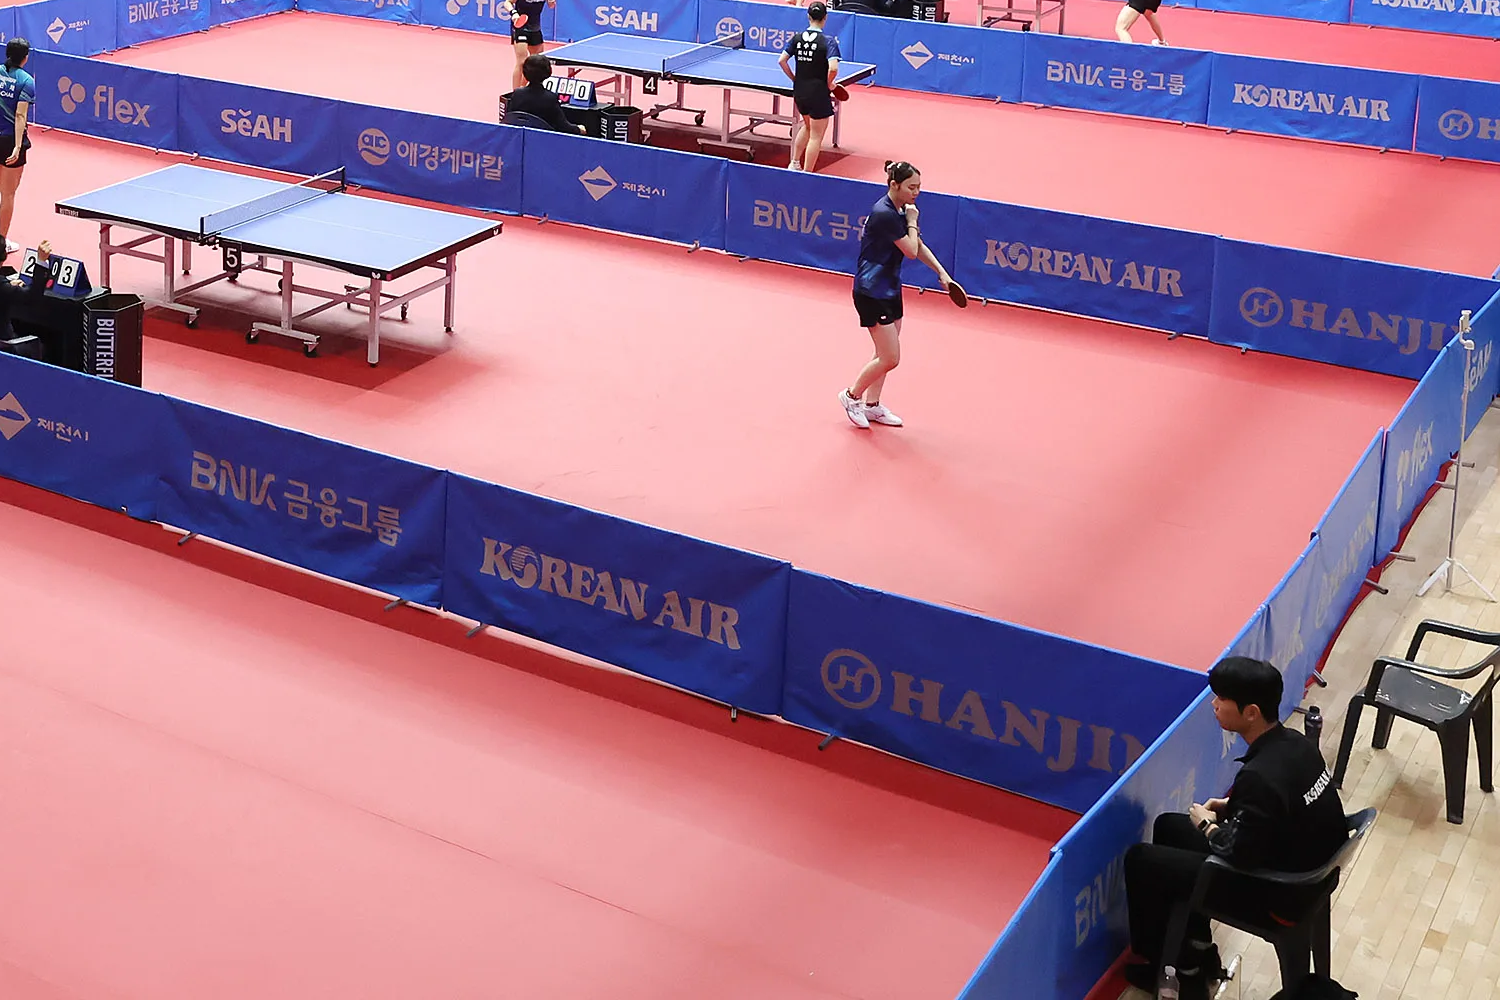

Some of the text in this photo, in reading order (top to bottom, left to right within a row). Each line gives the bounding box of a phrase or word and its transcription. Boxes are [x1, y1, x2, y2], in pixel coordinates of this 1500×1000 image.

[68, 19, 90, 32] 제천시
[129, 1, 159, 23] BNK
[937, 53, 975, 67] 제천시
[579, 85, 587, 99] 0
[645, 77, 656, 92] 4
[1047, 60, 1186, 96] BNK 금융그룹
[94, 85, 150, 128] flex
[1232, 83, 1391, 122] KOREAN AIR
[396, 140, 502, 182] 애경케미칼
[622, 181, 666, 200] 제천시
[753, 199, 823, 237] BNK
[25, 255, 36, 277] 2
[62, 265, 73, 285] 3
[226, 247, 238, 267] 5
[984, 239, 1183, 297] KOREAN AIR
[1290, 297, 1462, 355] HANJI
[36, 415, 90, 444] 제천시
[190, 449, 402, 548] BNK 금융그룹
[479, 536, 742, 651] KOREAN AIR
